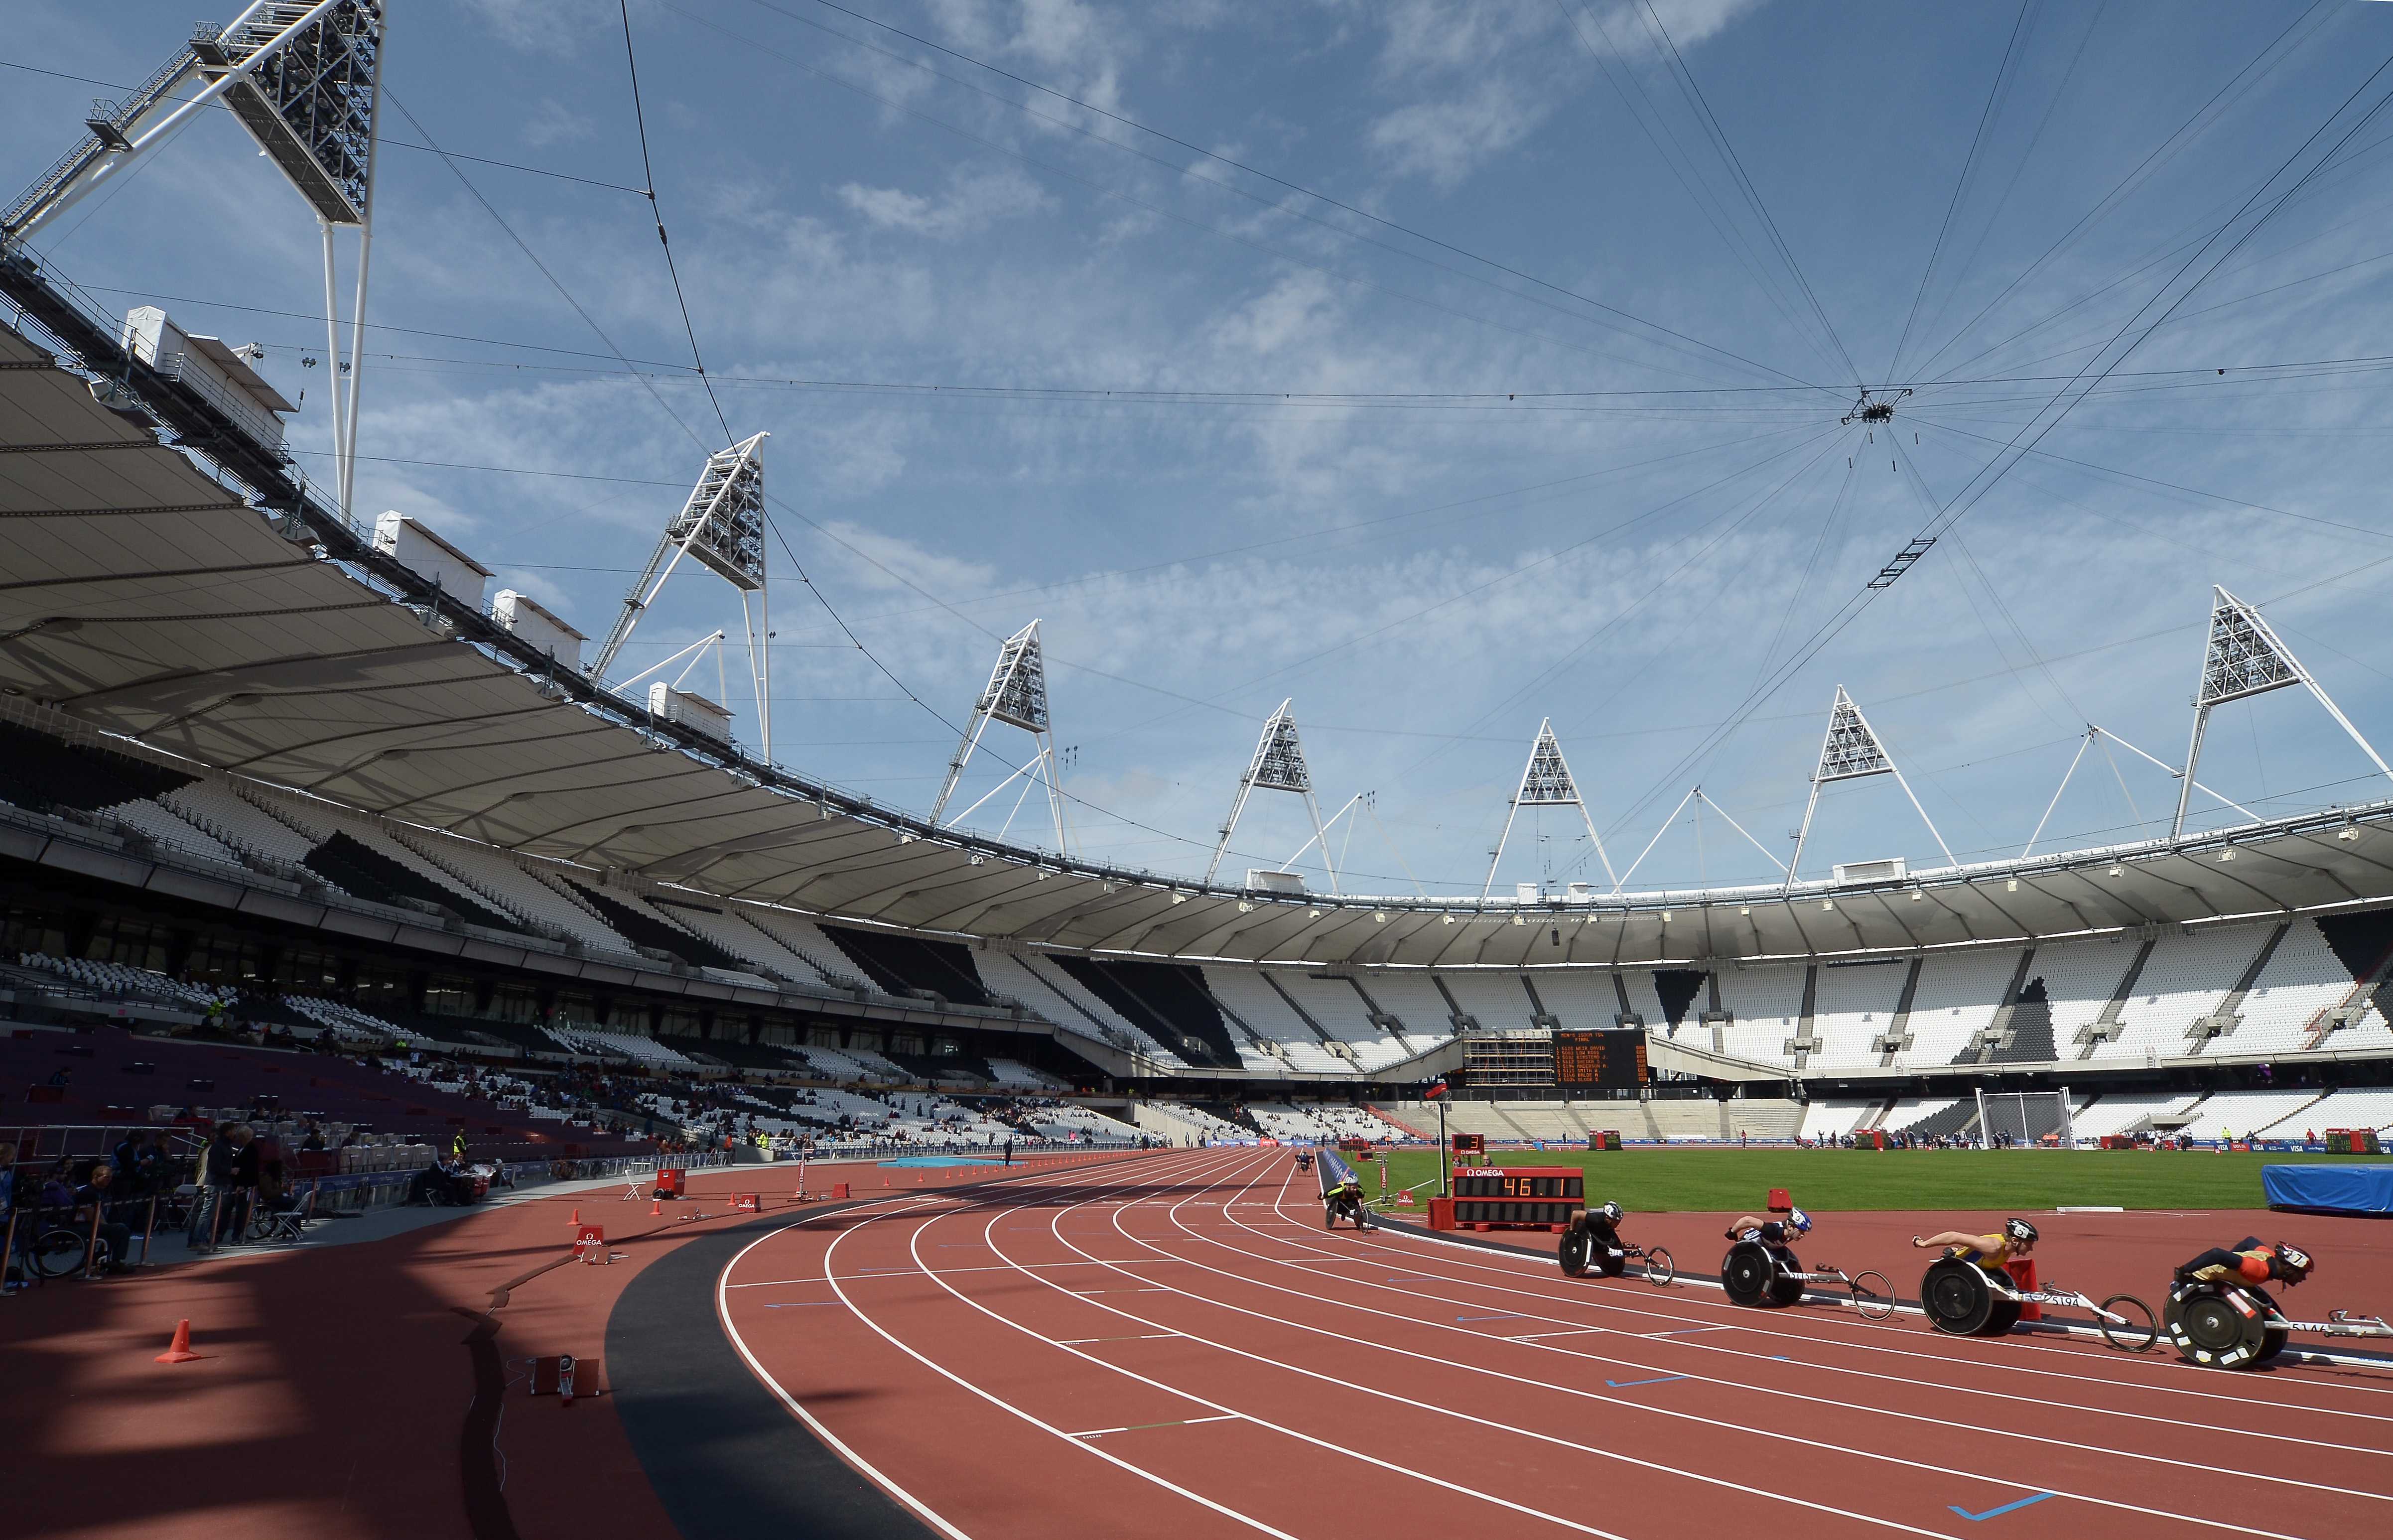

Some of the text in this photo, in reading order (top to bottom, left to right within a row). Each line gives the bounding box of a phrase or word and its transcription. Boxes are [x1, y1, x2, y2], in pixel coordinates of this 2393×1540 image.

[1471, 1137, 1478, 1149] 3
[2294, 1253, 2303, 1263] 7
[2052, 1296, 2080, 1307] 5194
[2292, 1323, 2326, 1332] 5146
